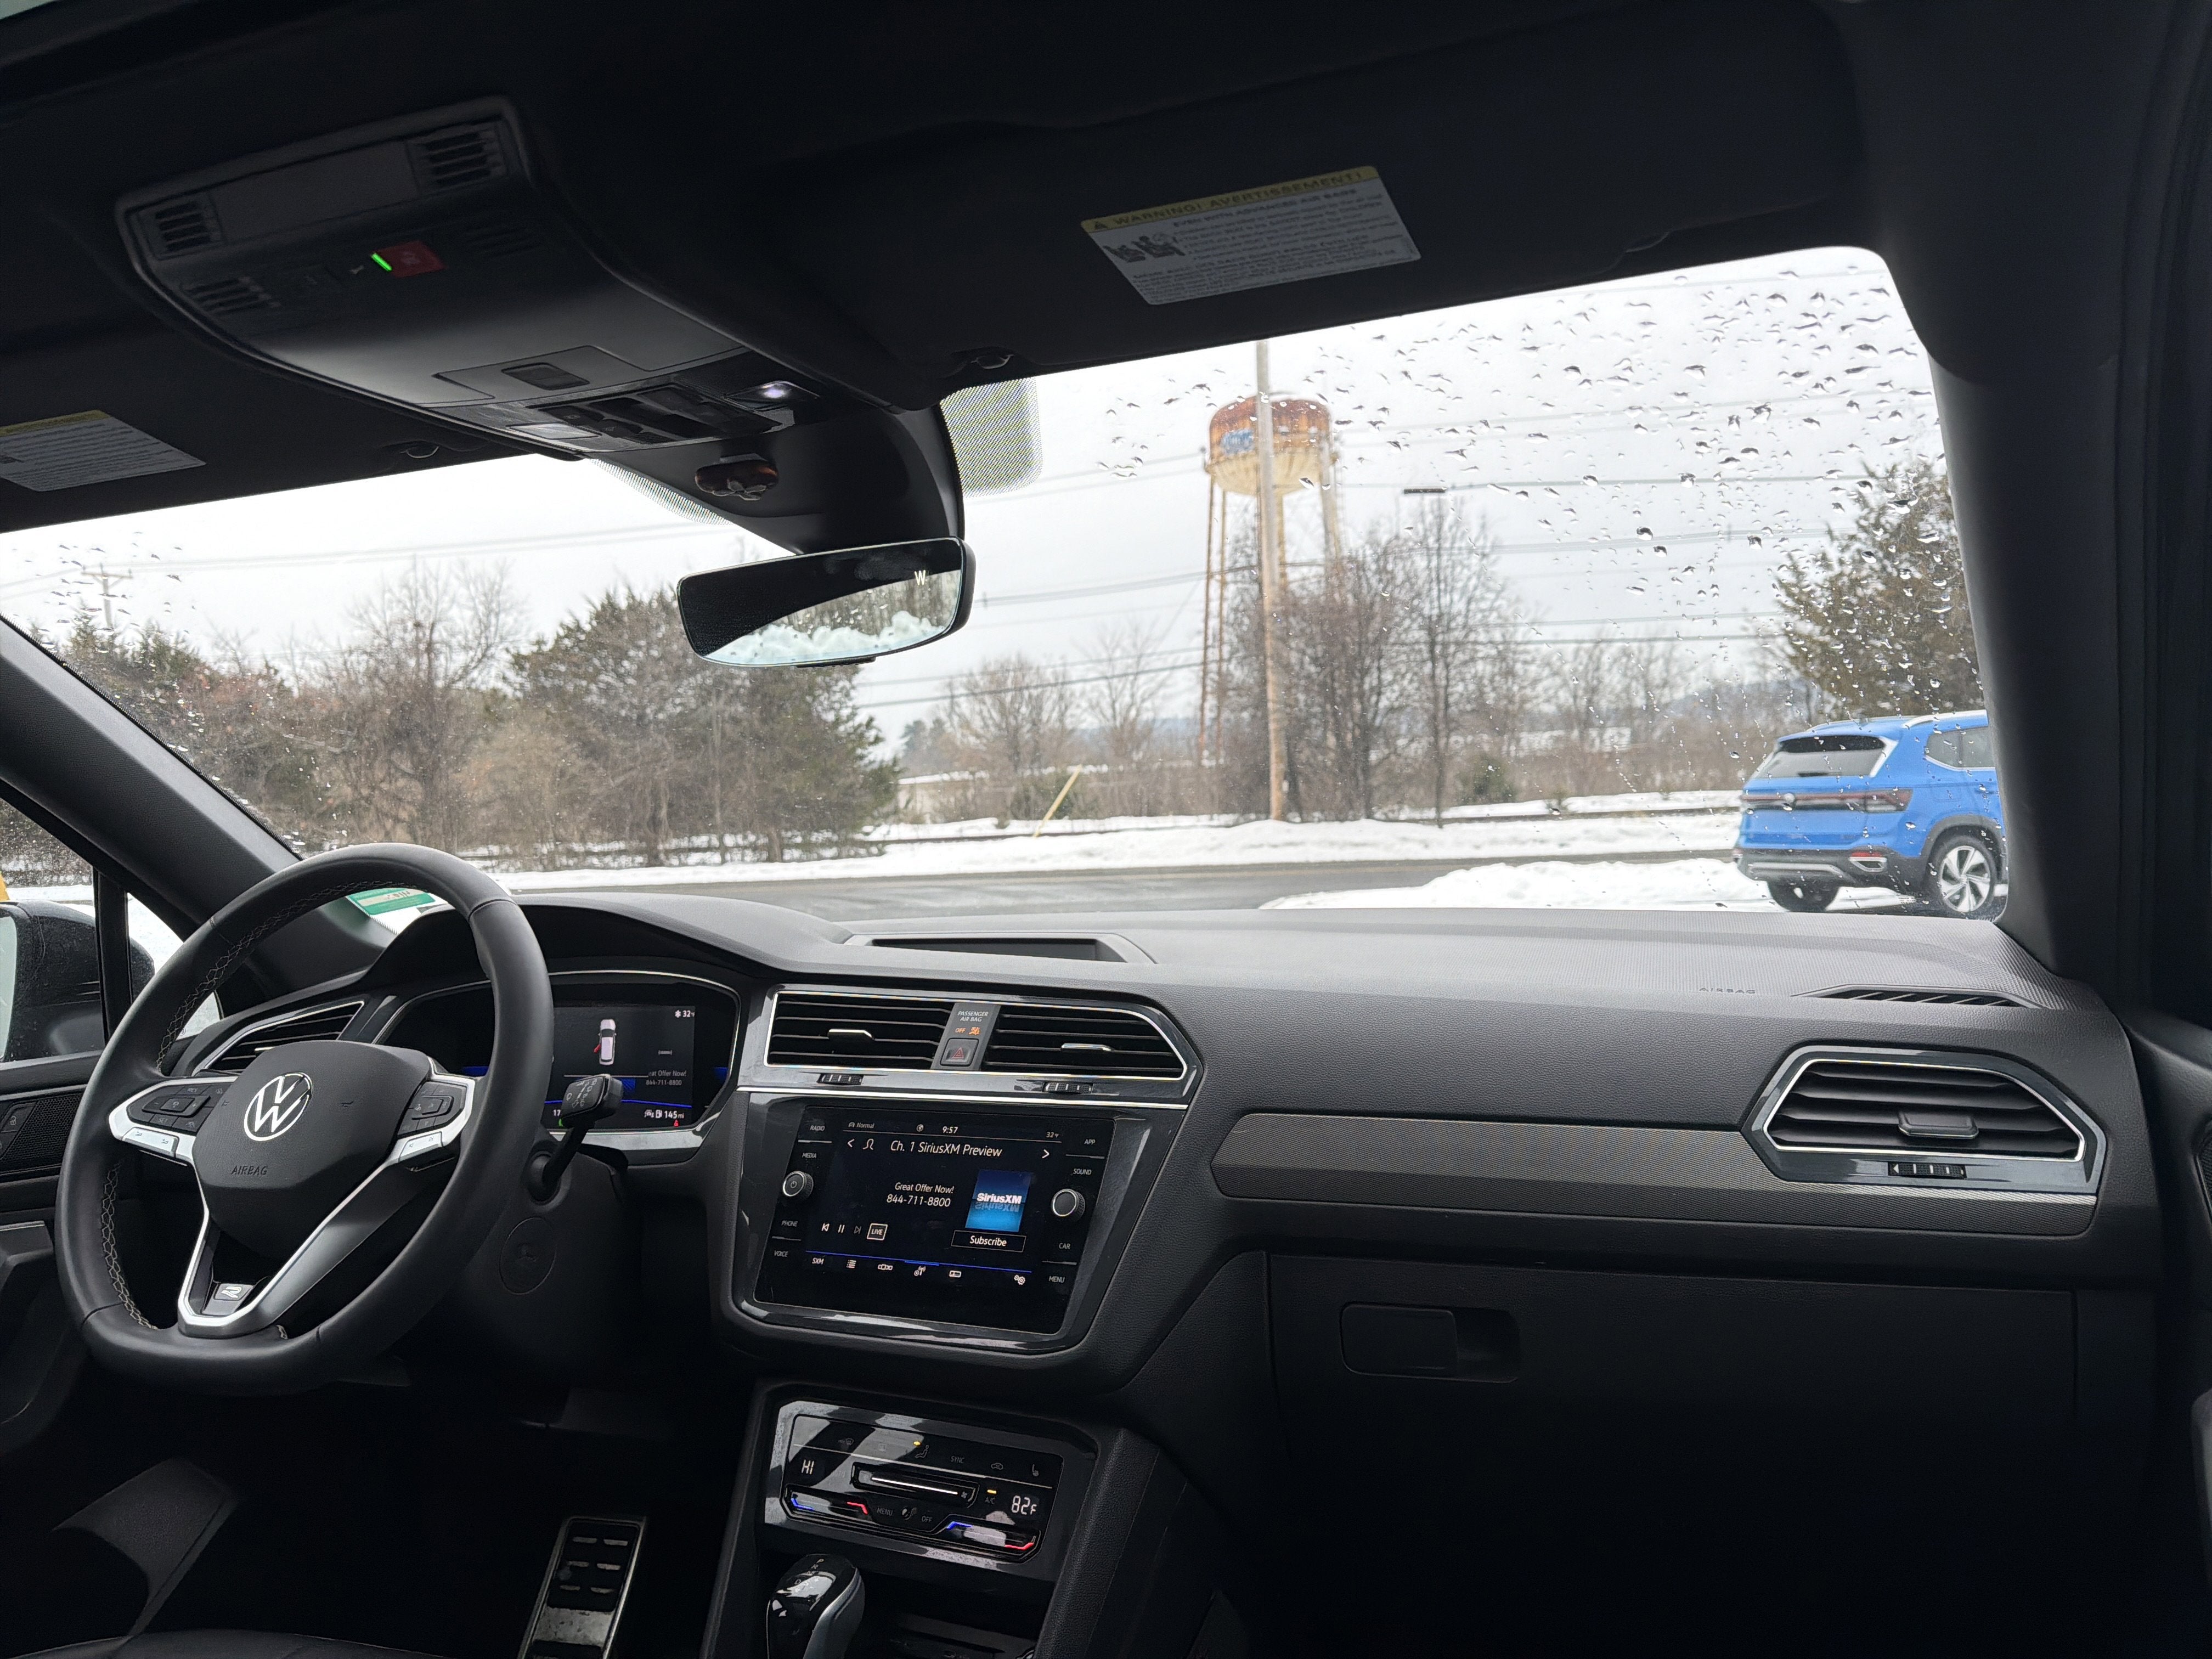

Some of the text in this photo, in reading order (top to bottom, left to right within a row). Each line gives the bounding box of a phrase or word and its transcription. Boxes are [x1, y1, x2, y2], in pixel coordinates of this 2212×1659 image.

[1113, 204, 1202, 224] WARNING!
[914, 569, 926, 586] W
[664, 1110, 678, 1119] 145
[942, 1125, 958, 1134] 9:57
[890, 1139, 1003, 1158] Ch. 1 SiriusXM Preview
[230, 1165, 268, 1175] AIRBAG
[895, 1182, 955, 1194] Great Offer Now!
[886, 1193, 951, 1207] 844-711-8800
[977, 1193, 1022, 1204] SiriusXM
[969, 1235, 1007, 1247] Subscribe
[812, 1257, 825, 1265] SXM
[950, 1455, 965, 1464] SYNC
[801, 1458, 815, 1475] HI
[876, 1506, 893, 1516] MENU
[921, 1515, 933, 1523] OFF
